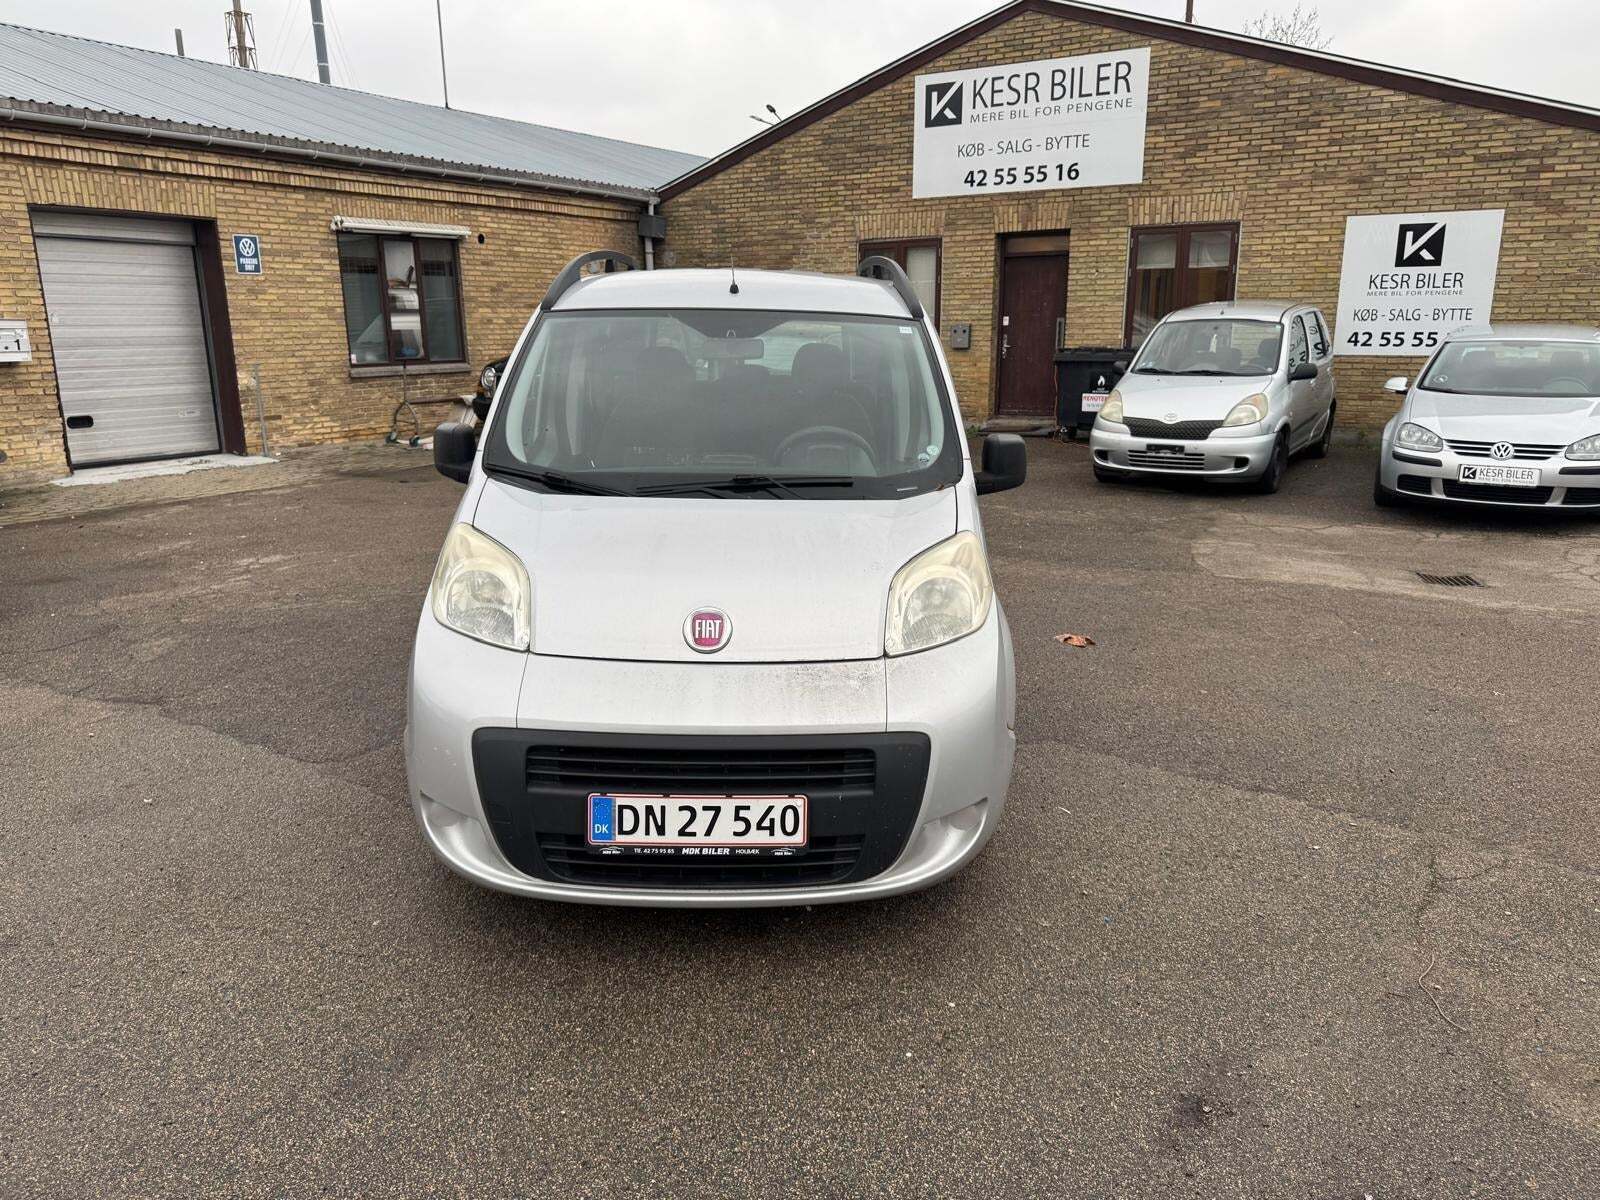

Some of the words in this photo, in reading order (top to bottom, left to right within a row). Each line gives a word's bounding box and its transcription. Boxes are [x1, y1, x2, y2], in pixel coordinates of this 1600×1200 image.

[972, 71, 1040, 110] KESR
[1051, 61, 1132, 101] BILER
[970, 112, 1004, 123] MERE
[1010, 109, 1029, 119] BIL
[1035, 106, 1061, 117] FOR
[1067, 98, 1133, 113] PENGENE
[957, 143, 984, 158] KØB
[997, 138, 1032, 155] SALG
[1045, 134, 1090, 151] BYTTE
[964, 169, 987, 187] 42
[993, 167, 1017, 186] 55
[1023, 165, 1048, 183] 55
[1056, 163, 1080, 181] 16
[1369, 273, 1411, 290] KESR
[1416, 272, 1464, 288] BILER
[1353, 308, 1378, 321] KØB
[1389, 308, 1421, 321] SALG
[1432, 308, 1473, 320] BYTTE
[1347, 332, 1373, 347] 42
[1379, 332, 1405, 347] 55
[1411, 332, 1438, 347] 55
[1479, 467, 1503, 477] KESR
[1506, 469, 1534, 479] BILER
[695, 619, 722, 639] FIAT
[594, 824, 609, 834] DK
[617, 804, 667, 837] DN
[677, 805, 721, 837] 27
[732, 804, 800, 837] 540
[681, 847, 700, 855] MDK
[702, 847, 730, 855] BILER
